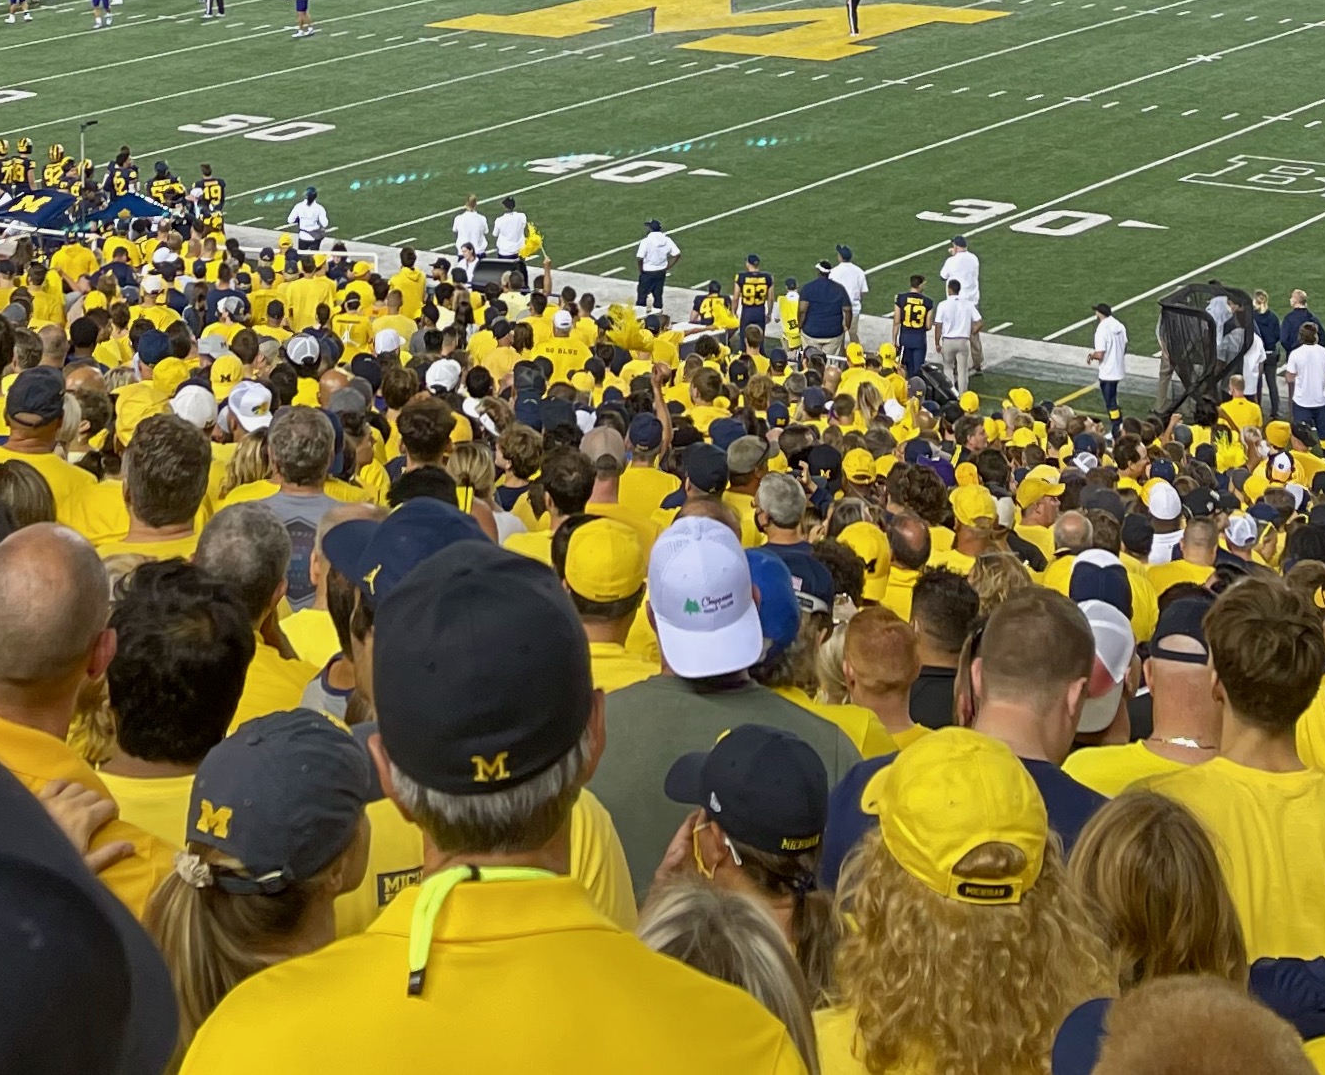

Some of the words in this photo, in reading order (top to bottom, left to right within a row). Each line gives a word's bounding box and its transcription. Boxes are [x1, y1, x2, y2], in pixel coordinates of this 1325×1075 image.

[178, 113, 336, 141] 50
[526, 154, 689, 184] 40
[203, 187, 222, 206] 19
[915, 198, 1114, 237] 30
[741, 284, 768, 307] 93
[903, 304, 926, 328] 13
[220, 374, 232, 383] M
[470, 751, 512, 783] M
[195, 798, 234, 839] M
